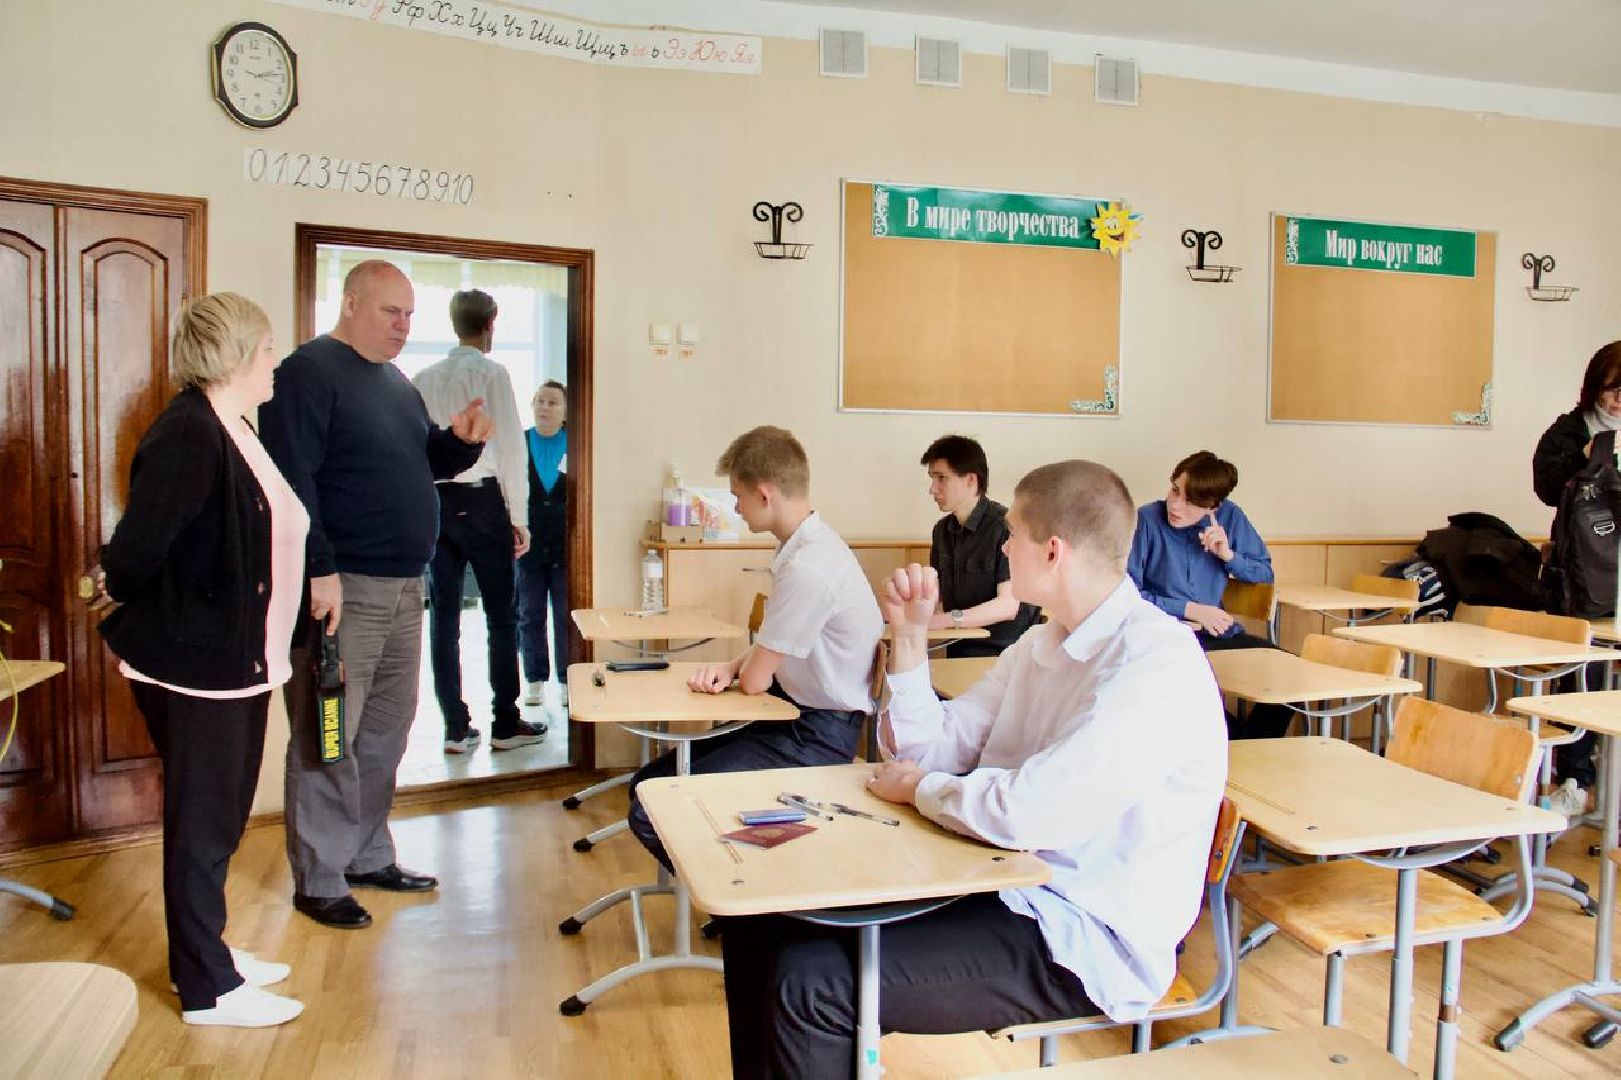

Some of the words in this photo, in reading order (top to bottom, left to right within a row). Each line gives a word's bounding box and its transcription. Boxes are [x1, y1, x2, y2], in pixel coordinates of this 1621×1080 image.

[906, 196, 920, 228] В
[925, 204, 972, 238] мире
[976, 209, 1080, 241] творчества
[1324, 229, 1357, 265] Мир
[1361, 238, 1412, 270] вокруг
[1416, 243, 1443, 266] нас
